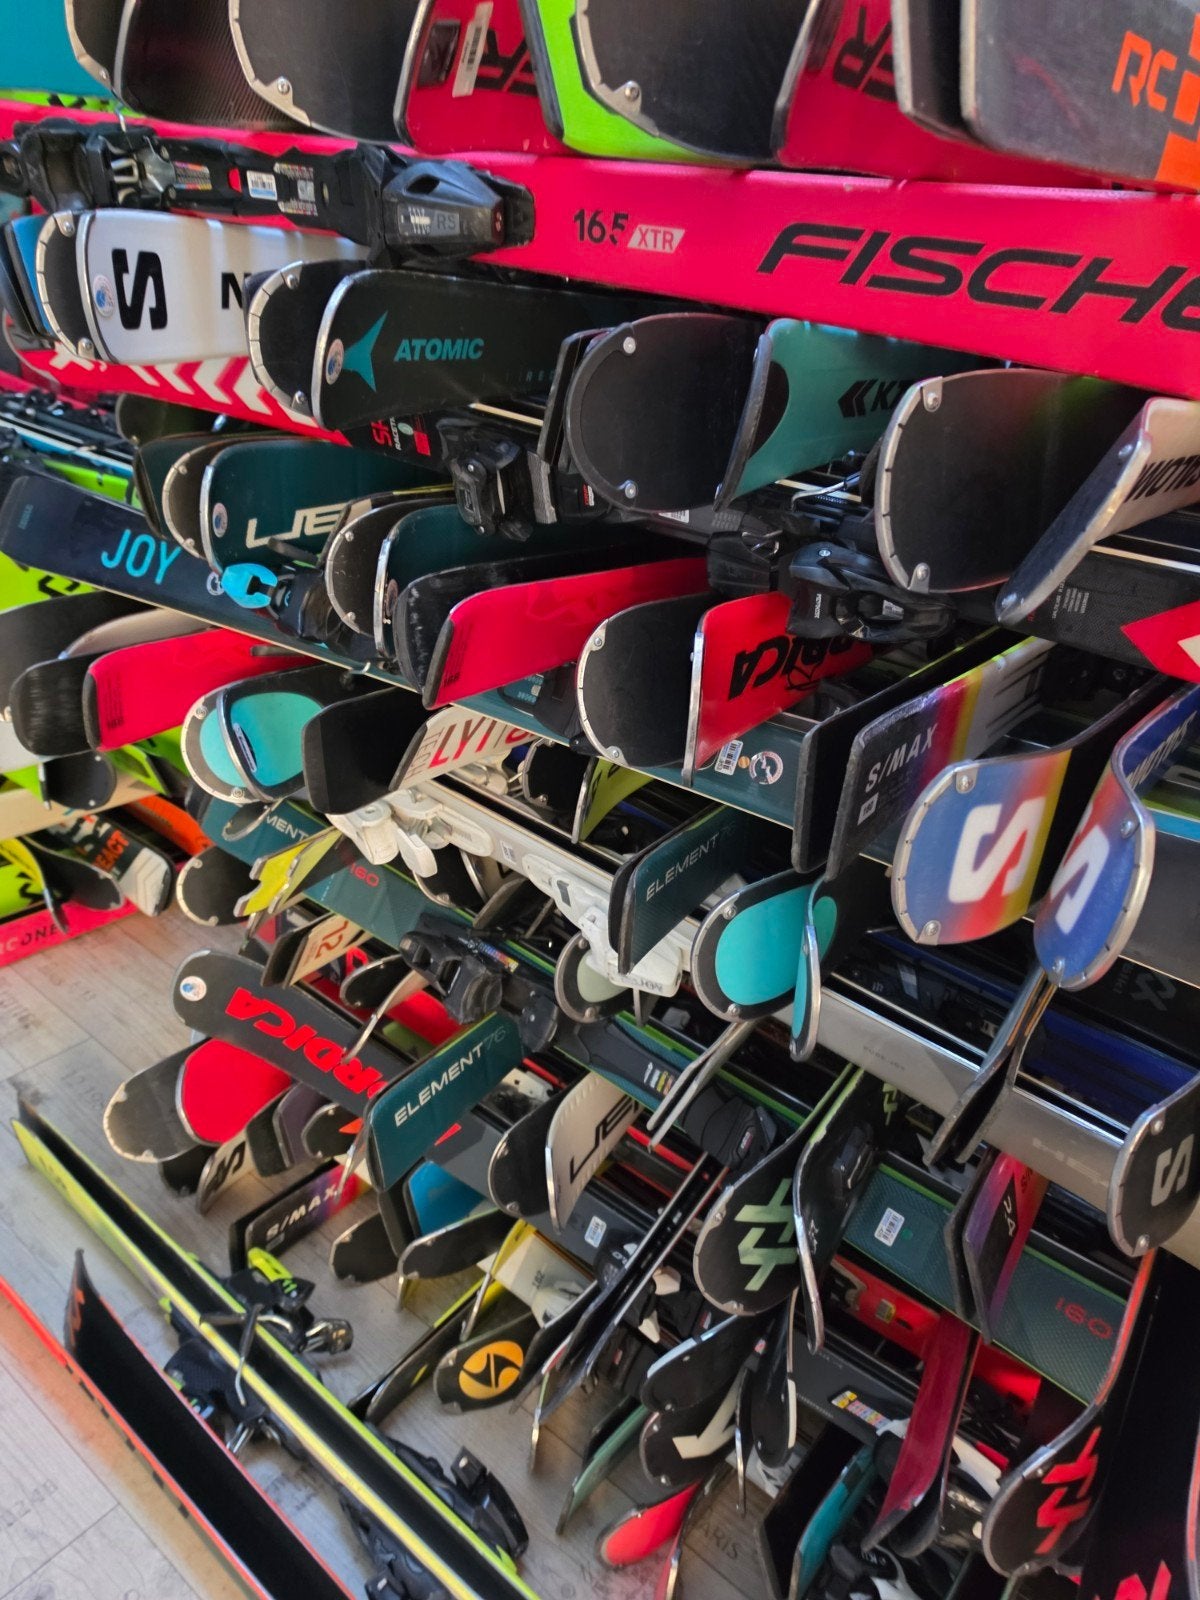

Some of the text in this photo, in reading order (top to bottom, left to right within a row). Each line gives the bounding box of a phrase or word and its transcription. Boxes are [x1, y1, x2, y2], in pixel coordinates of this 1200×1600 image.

[1111, 29, 1178, 113] RC
[573, 208, 677, 251] 165 XTR
[393, 337, 486, 363] ATOMIC
[100, 529, 182, 586] JOY
[865, 722, 939, 793] S/MAX
[645, 831, 720, 902] ELEMENT
[394, 1041, 484, 1128] ELEMENT
